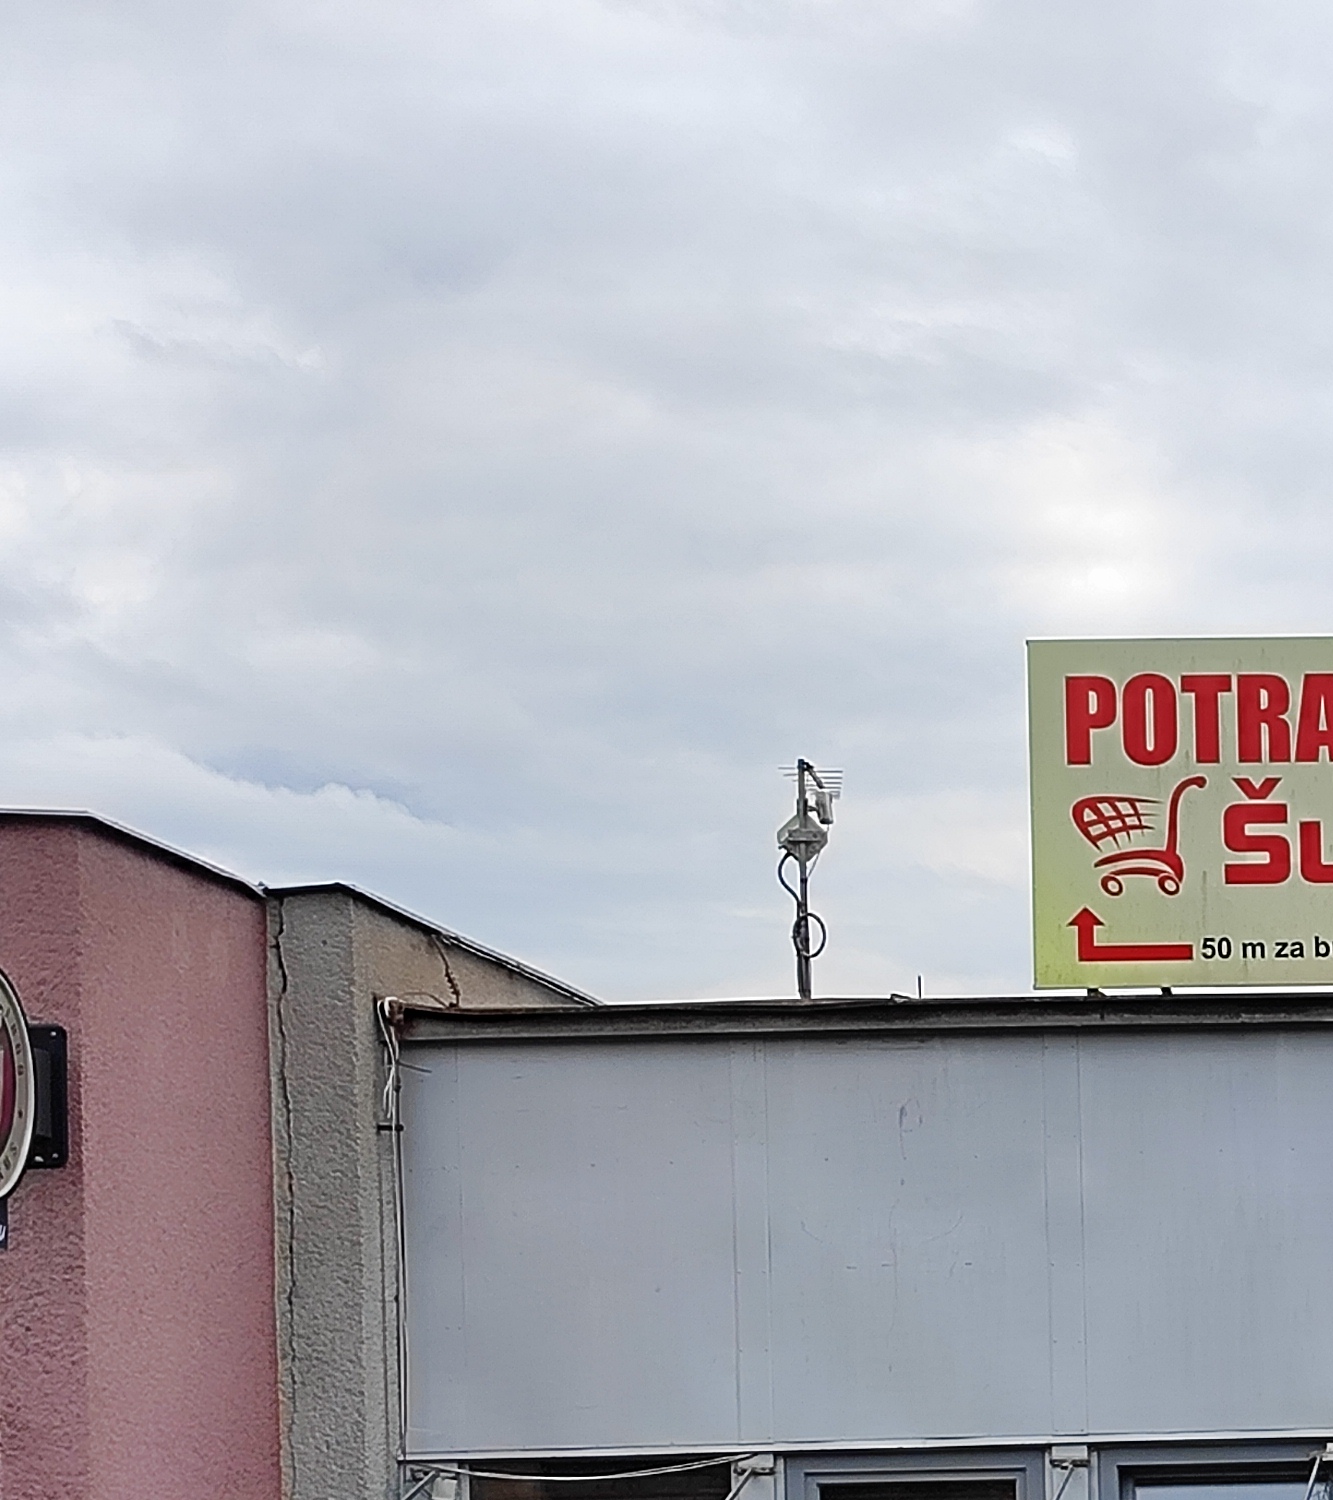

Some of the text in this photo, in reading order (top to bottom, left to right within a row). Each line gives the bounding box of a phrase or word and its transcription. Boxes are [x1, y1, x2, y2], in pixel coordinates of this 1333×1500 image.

[1201, 936, 1232, 960] 50
[1241, 941, 1266, 959] m
[1274, 941, 1305, 959] za
